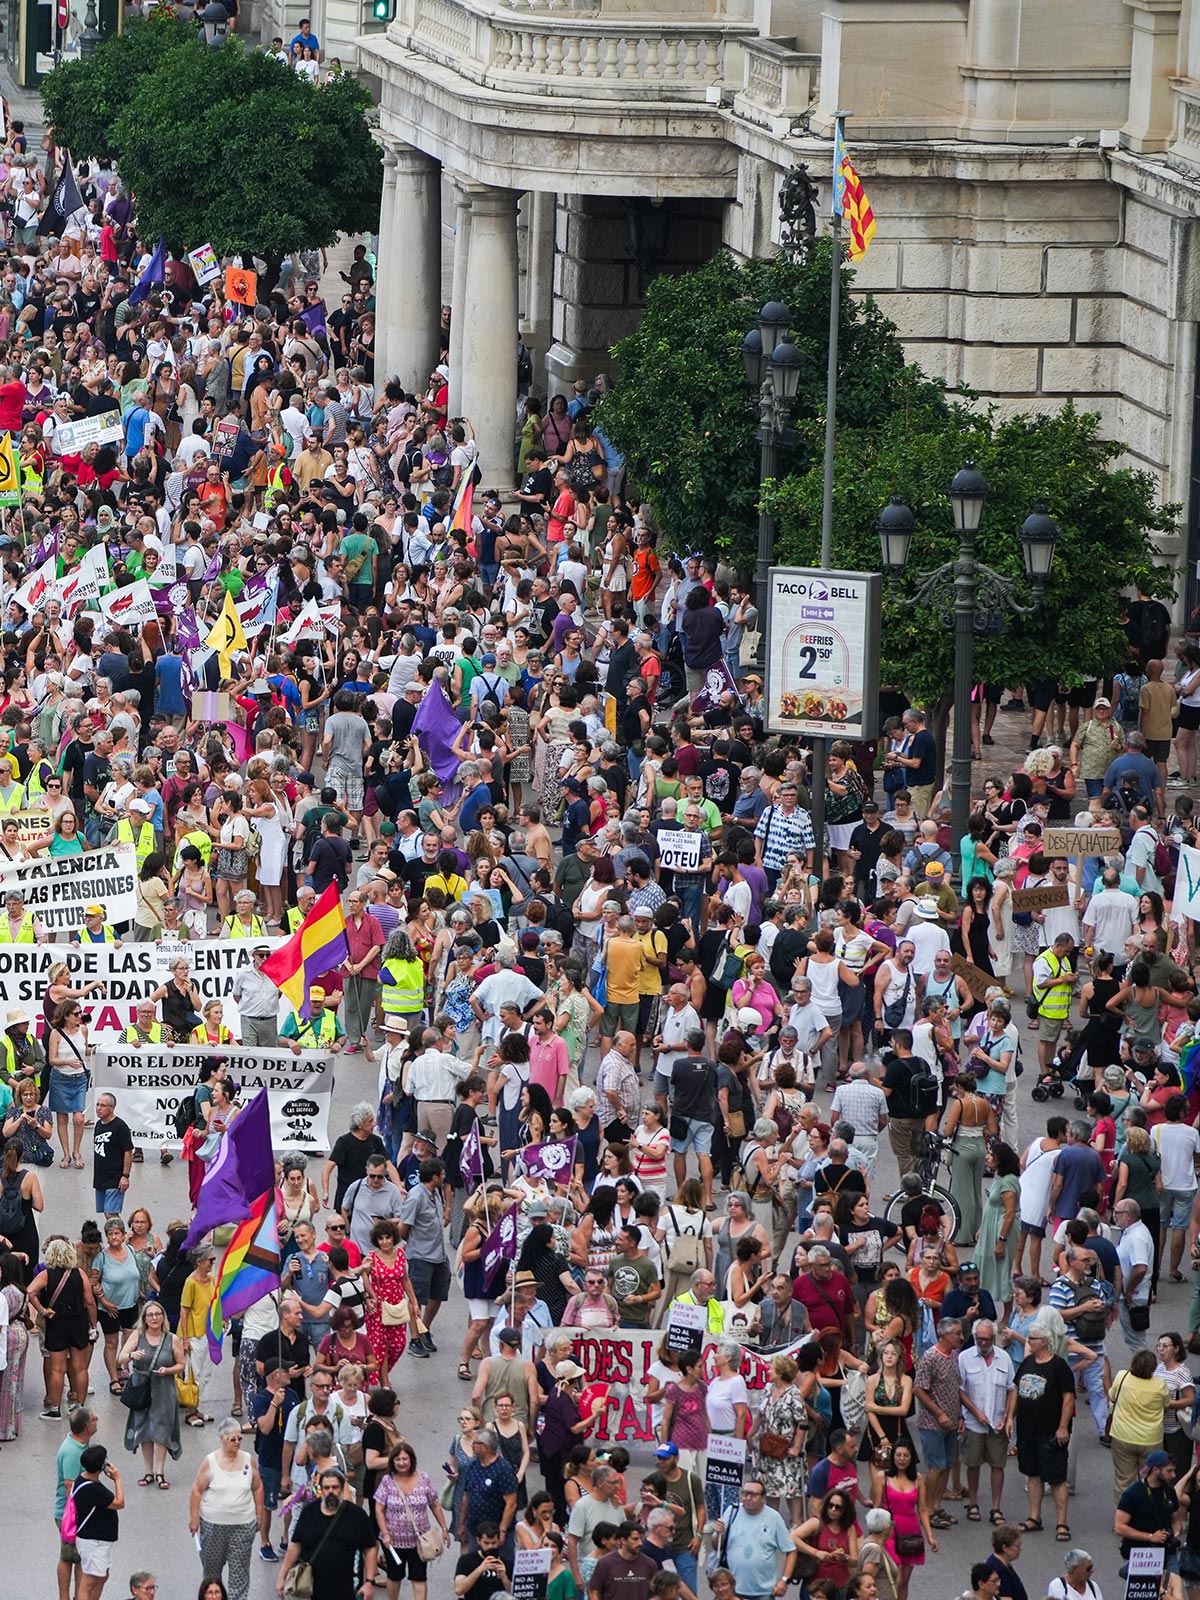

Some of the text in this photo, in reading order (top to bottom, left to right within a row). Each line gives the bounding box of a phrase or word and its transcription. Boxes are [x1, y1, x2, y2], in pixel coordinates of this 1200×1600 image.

[777, 583, 858, 599] TACO BELL
[800, 635, 833, 646] BEEFRIES
[435, 650, 455, 660] GOOD
[1048, 832, 1120, 854] DESFACHATEZ
[16, 854, 120, 881] VALENCIA
[52, 875, 134, 902] PENSIONES
[66, 953, 98, 973] DE
[108, 952, 152, 973] LAS
[195, 948, 251, 971] ENTA
[18, 979, 160, 1001] SEURIDAD
[190, 976, 234, 998] OCIA
[107, 1056, 326, 1074] POR EL DERHO DE LAS
[127, 1074, 204, 1087] PERSONA
[240, 1075, 263, 1088] LA
[269, 1077, 305, 1090] PAZ
[155, 1098, 178, 1110] NO
[669, 1334, 690, 1343] BLANC
[710, 1448, 742, 1457] LLIBERTAT
[708, 1464, 719, 1472] NO
[707, 1473, 741, 1484] CENSURA
[1132, 1561, 1161, 1569] LLIBERTAT
[1130, 1582, 1140, 1590] NO
[1128, 1591, 1158, 1599] CENSURA
